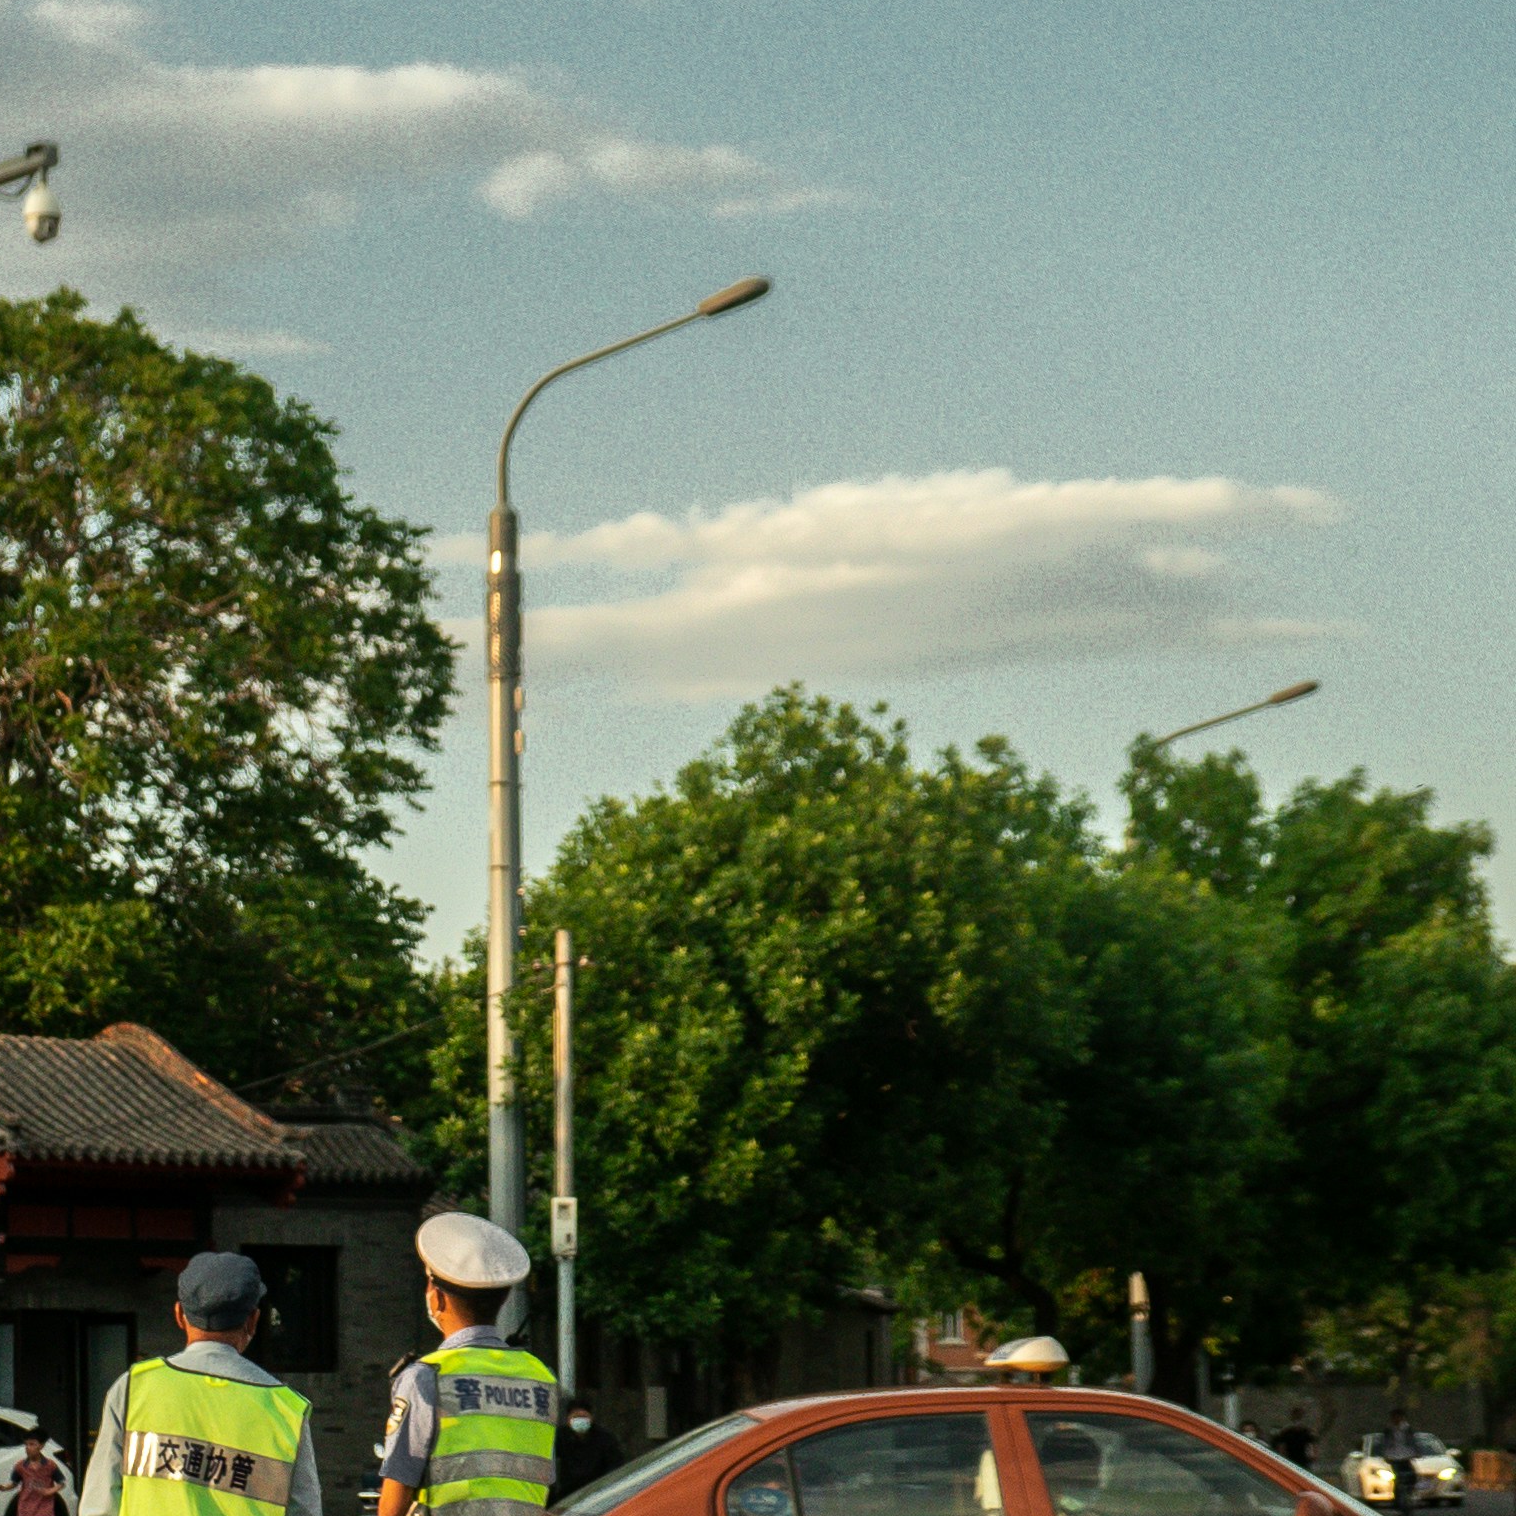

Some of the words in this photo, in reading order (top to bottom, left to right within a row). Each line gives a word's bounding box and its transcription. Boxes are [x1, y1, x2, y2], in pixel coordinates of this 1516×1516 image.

[454, 1378, 483, 1411] 警
[485, 1385, 533, 1409] POLICE
[532, 1386, 551, 1417] 察
[155, 1439, 256, 1491] 交通协管
